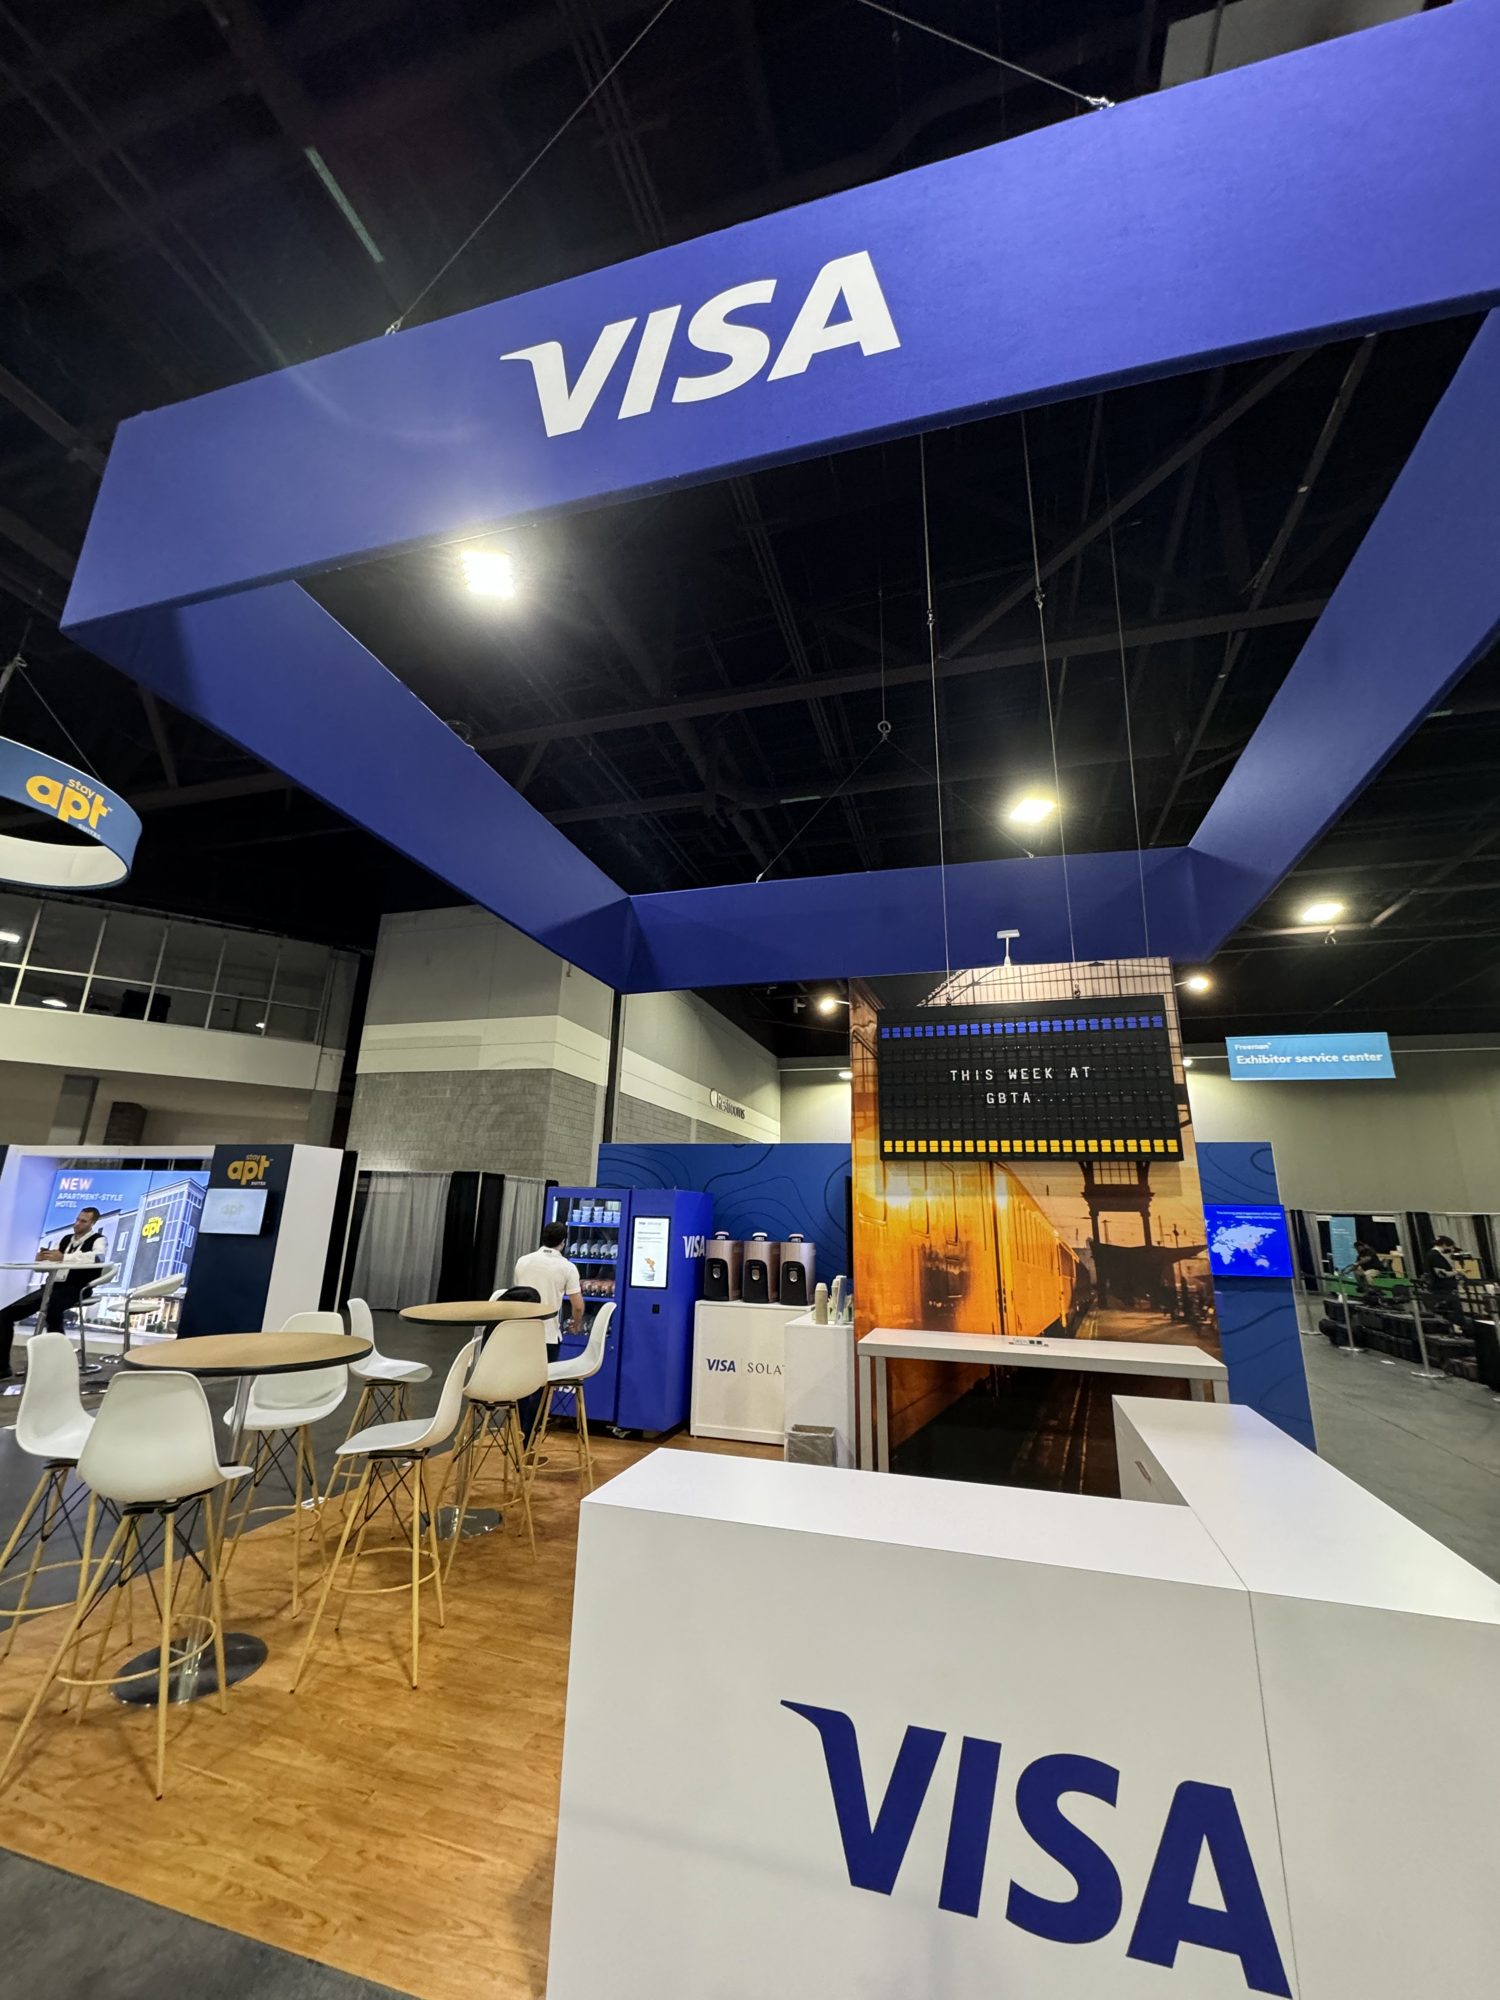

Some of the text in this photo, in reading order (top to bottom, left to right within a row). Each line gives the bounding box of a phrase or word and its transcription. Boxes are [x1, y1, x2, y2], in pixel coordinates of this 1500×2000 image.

[500, 250, 901, 438] VISA
[67, 778, 96, 798] stay
[26, 775, 108, 830] apt
[1236, 1052, 1384, 1065] Exhibitor service center
[950, 1066, 1091, 1081] THIS WEEK AT
[227, 1154, 271, 1186] apt
[59, 1177, 93, 1191] NEW
[682, 1235, 705, 1258] VISA
[706, 1358, 785, 1375] VISA SOLA
[779, 1699, 1294, 2000] VISA
